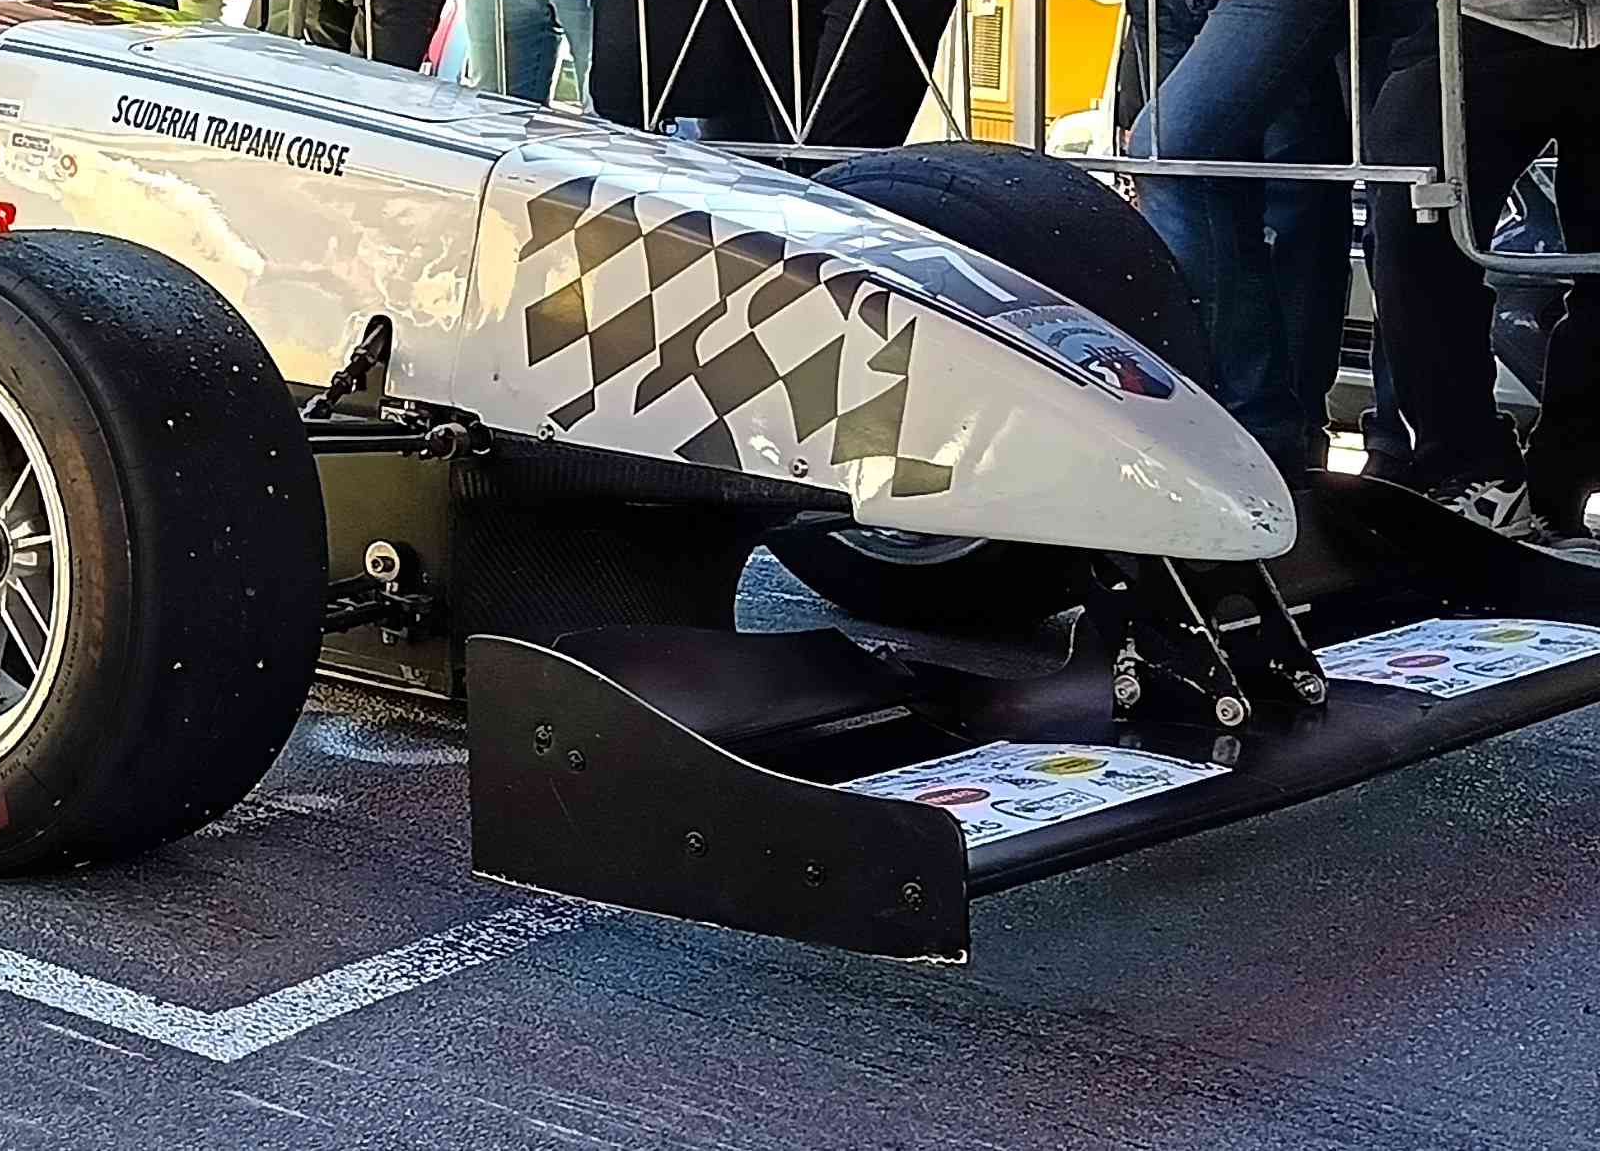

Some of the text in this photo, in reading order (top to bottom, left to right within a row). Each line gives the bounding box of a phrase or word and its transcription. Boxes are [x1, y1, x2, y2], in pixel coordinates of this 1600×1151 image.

[112, 95, 350, 177] SCUDERIA TRAPANI CORSE
